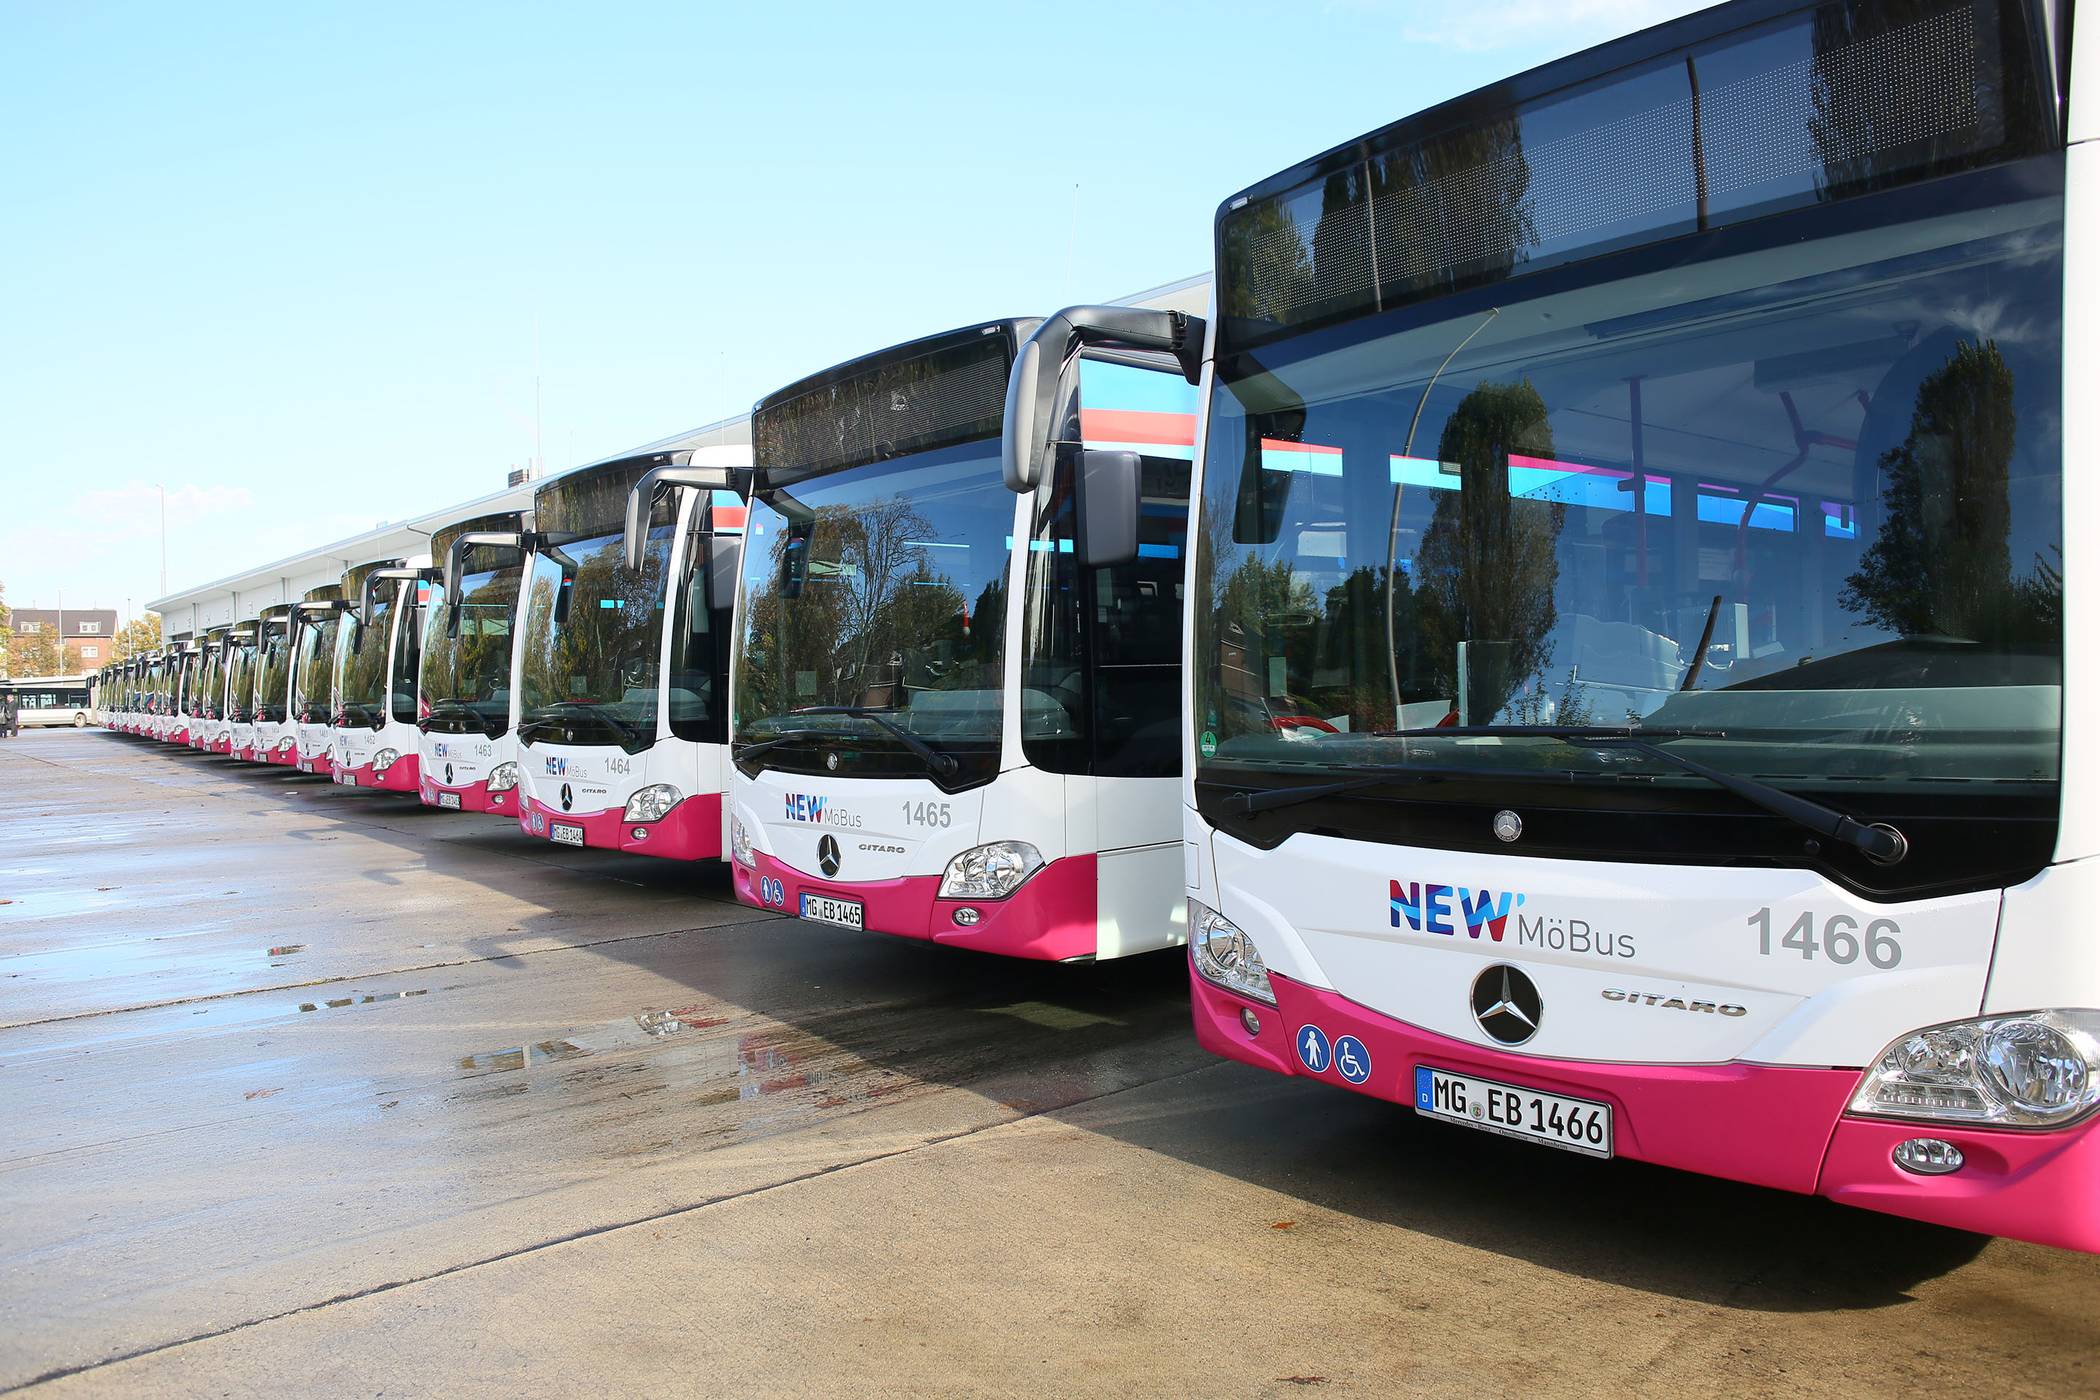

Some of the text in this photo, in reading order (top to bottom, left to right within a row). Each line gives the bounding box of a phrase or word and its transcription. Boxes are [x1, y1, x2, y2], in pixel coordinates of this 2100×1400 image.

[474, 743, 492, 758] 1463
[604, 757, 631, 775] 1464
[824, 808, 862, 828] MöBus
[902, 800, 952, 829] 1465
[858, 843, 906, 854] CITARO
[806, 897, 818, 916] MG
[836, 903, 861, 925] 1465
[1518, 914, 1636, 958] MöBus
[1747, 907, 1902, 970] 1466
[1601, 988, 1748, 1017] CITARO
[1422, 1093, 1429, 1103] D
[1433, 1076, 1467, 1114] MG
[1529, 1098, 1603, 1145] 1466
